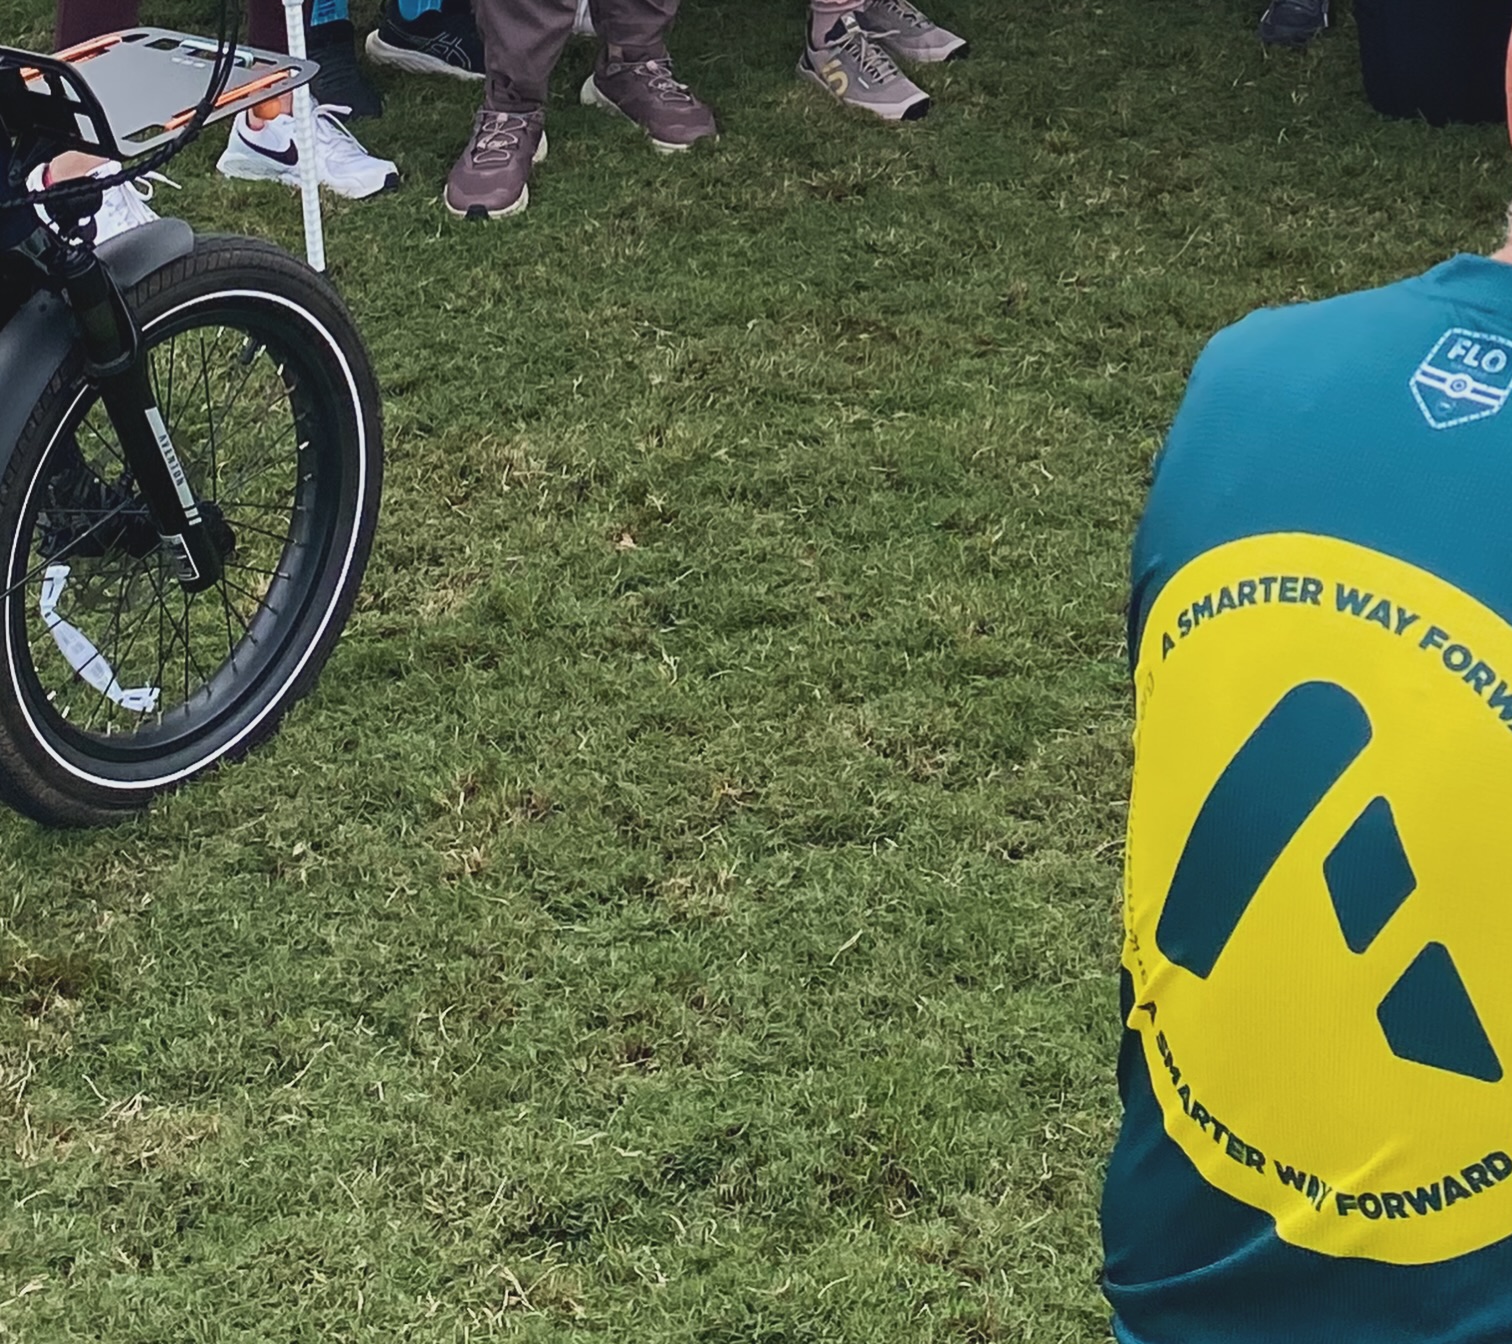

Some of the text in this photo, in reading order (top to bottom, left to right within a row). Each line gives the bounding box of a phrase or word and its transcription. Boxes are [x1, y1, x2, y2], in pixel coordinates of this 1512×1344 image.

[1446, 337, 1507, 373] FLO
[1162, 631, 1176, 663] A
[1177, 576, 1324, 640] SMARTER
[1335, 582, 1421, 636] WAY
[1156, 1029, 1267, 1176] SMARTER
[1273, 1159, 1333, 1212] WAY
